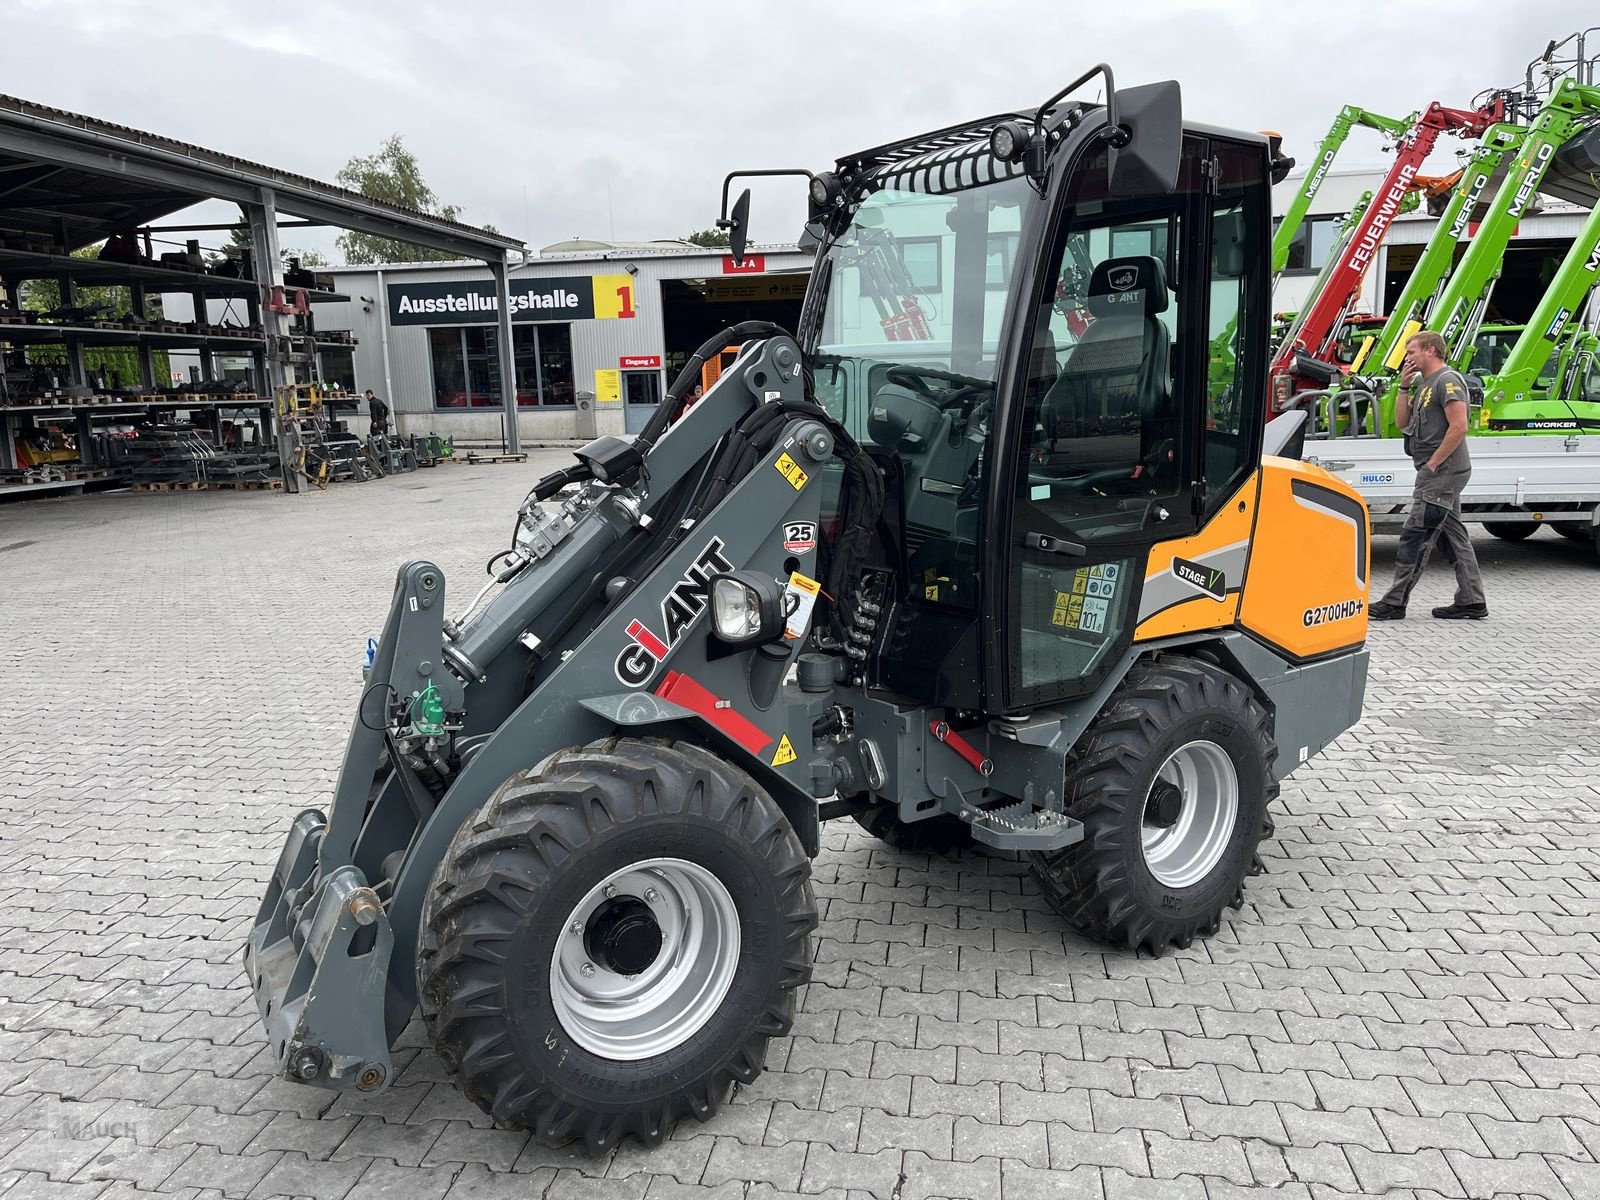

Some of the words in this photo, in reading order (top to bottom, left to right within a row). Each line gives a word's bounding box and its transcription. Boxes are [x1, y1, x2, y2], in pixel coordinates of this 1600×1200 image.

[1304, 150, 1335, 198] MERLO
[1507, 143, 1554, 217] MERLO
[1349, 164, 1417, 272] FEUERWEHR
[1449, 174, 1488, 238] MERLO
[731, 259, 747, 269] Tr
[748, 258, 756, 268] A
[616, 286, 636, 319] 1
[1107, 291, 1139, 303] GANT
[1446, 316, 1461, 339] 33.7
[1551, 311, 1569, 337] 25.5
[625, 358, 649, 366] Eingang
[649, 357, 655, 365] A
[789, 526, 811, 542] 25
[1178, 565, 1206, 586] STAGE
[1208, 568, 1224, 590] V
[1082, 611, 1098, 630] 101
[1302, 597, 1364, 627] G2700HD+
